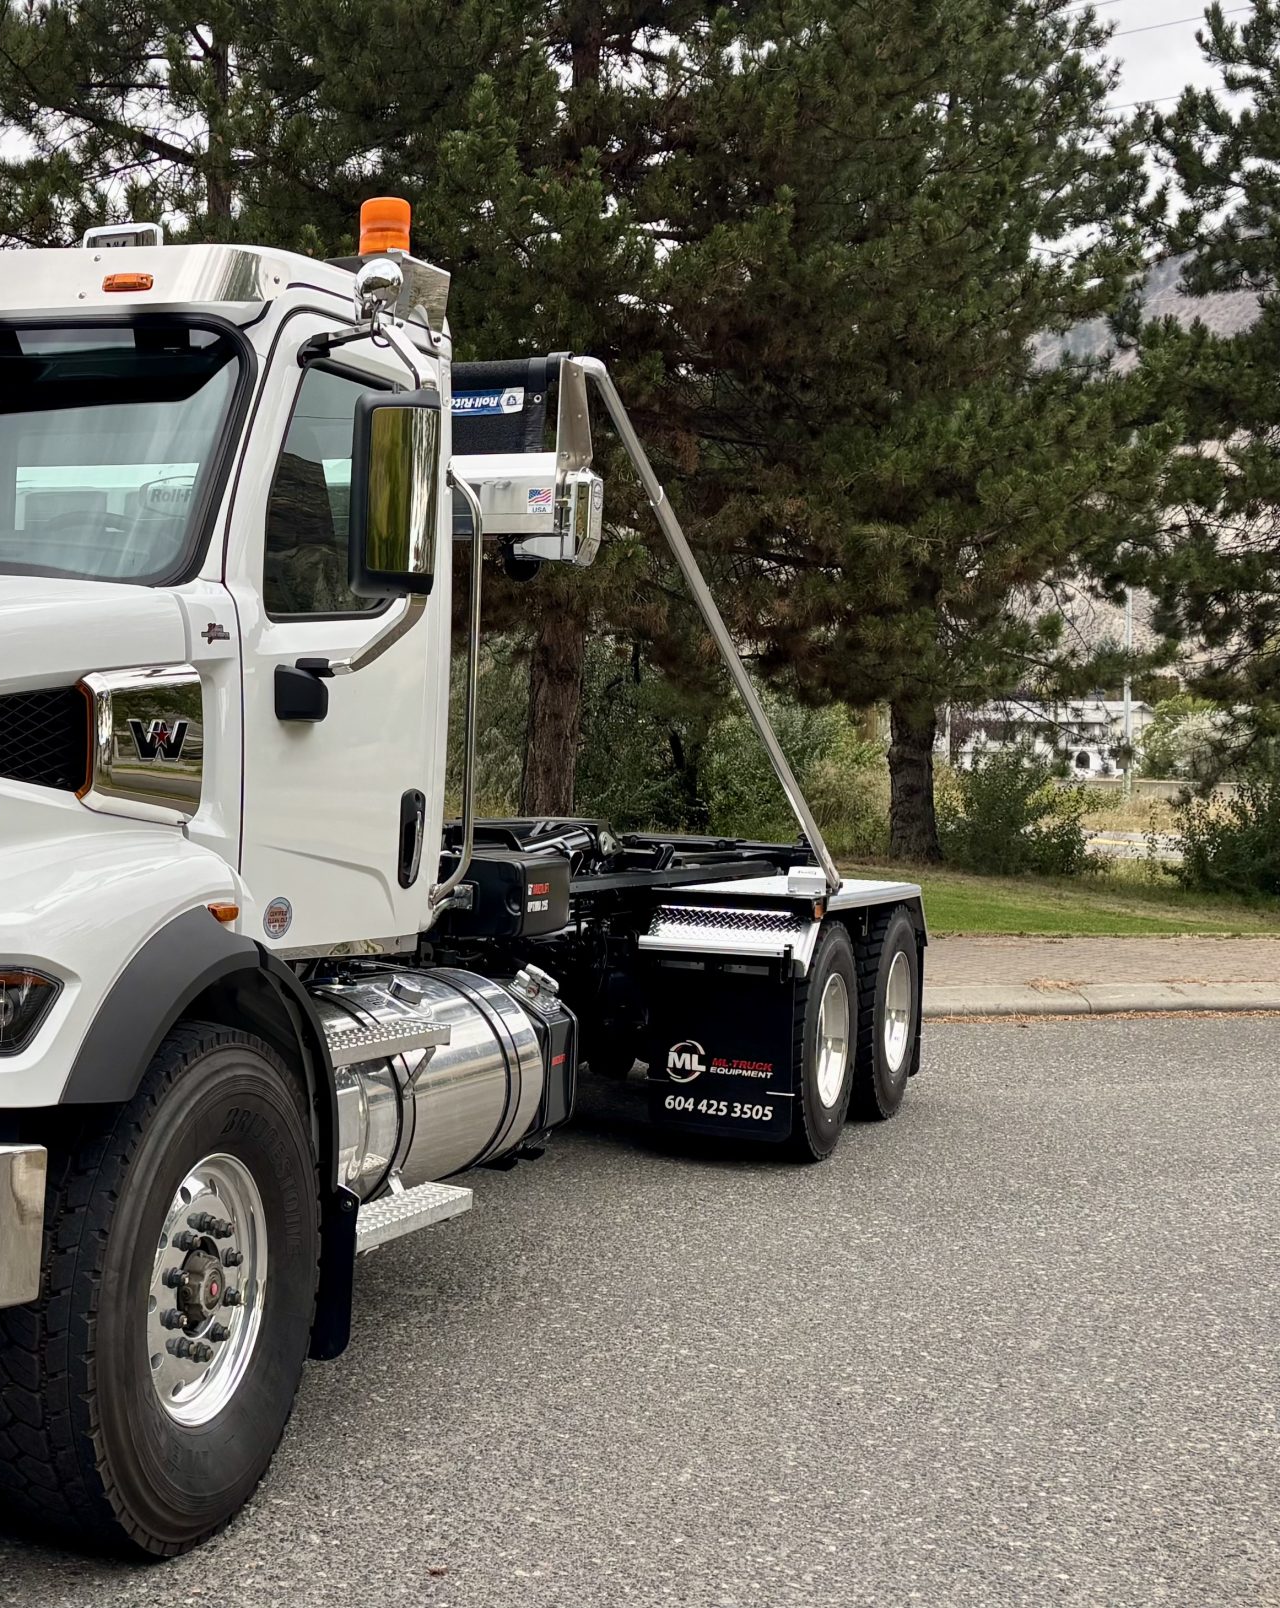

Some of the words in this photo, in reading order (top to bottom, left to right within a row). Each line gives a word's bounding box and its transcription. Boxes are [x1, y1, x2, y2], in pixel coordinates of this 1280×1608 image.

[667, 1051, 706, 1072] ML
[709, 1066, 774, 1079] EQUIPMENT
[665, 1095, 694, 1112] 604
[697, 1099, 728, 1116] 425
[730, 1102, 774, 1121] 3505
[220, 1107, 304, 1256] BRIDGESTONE
